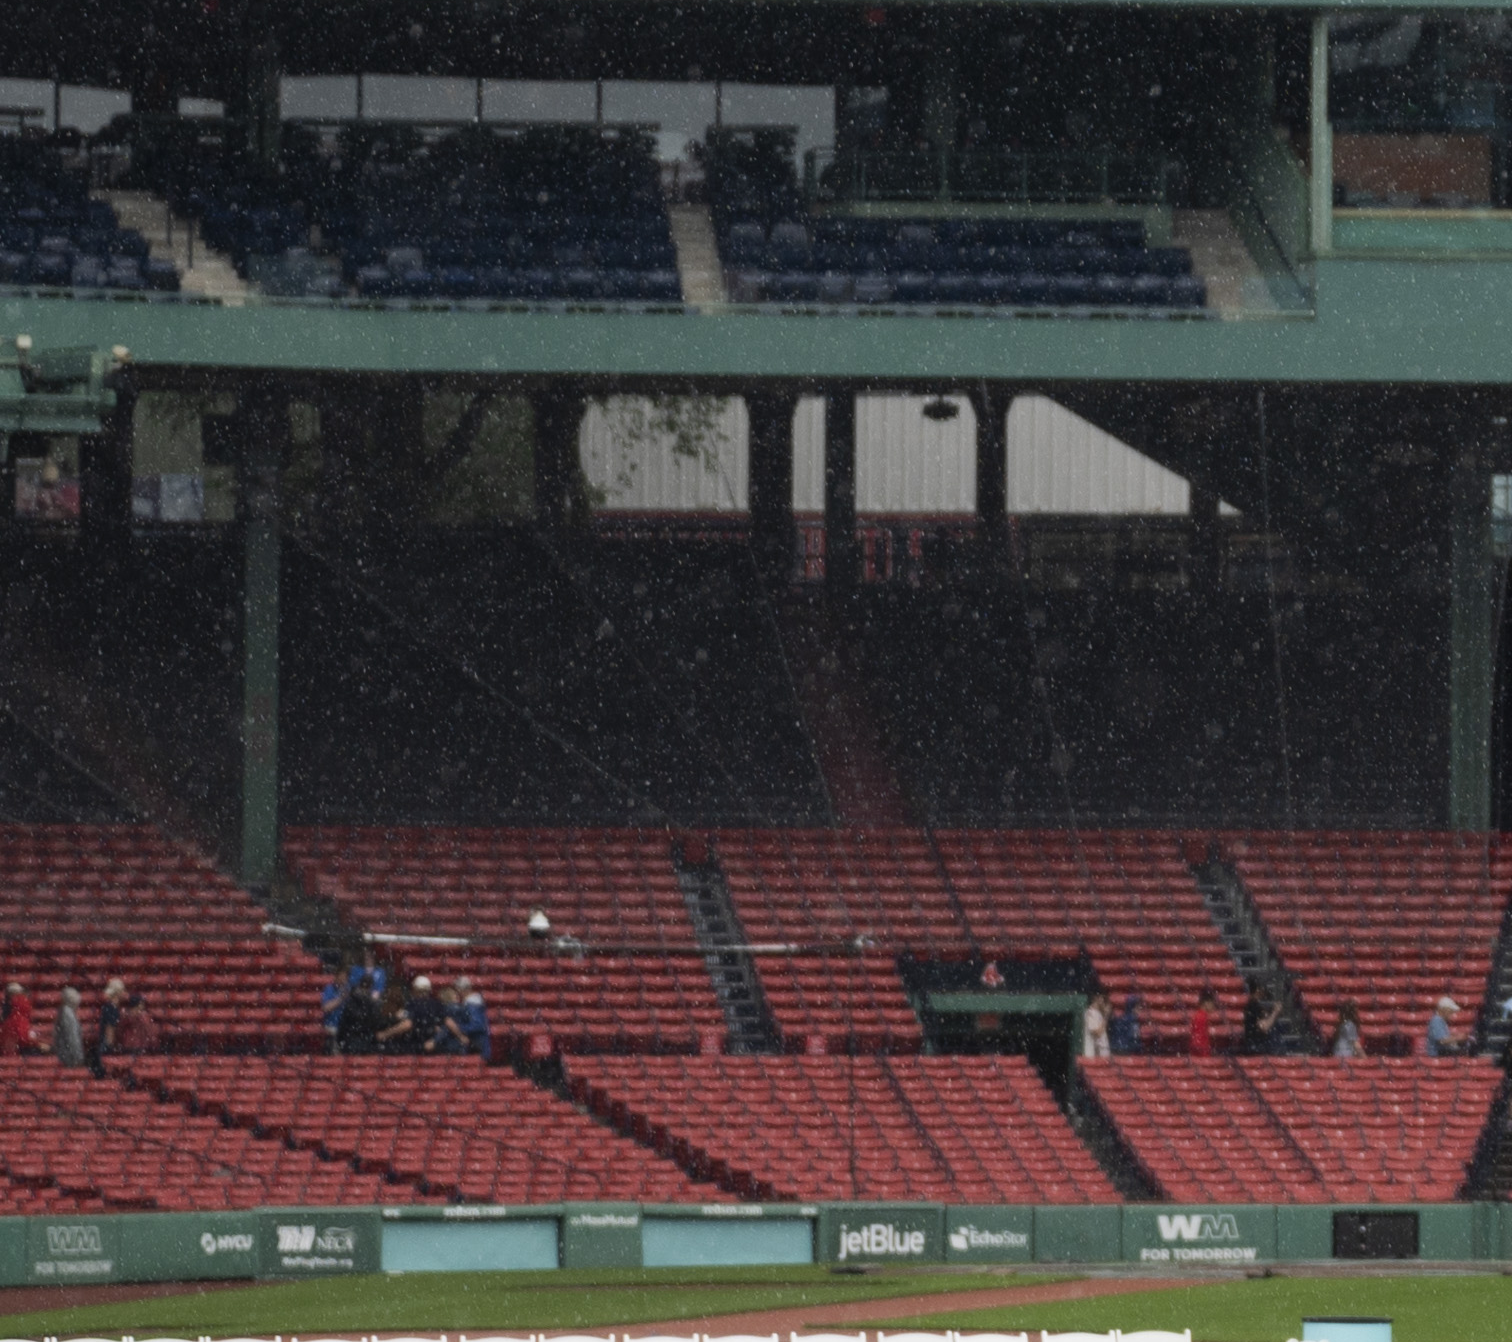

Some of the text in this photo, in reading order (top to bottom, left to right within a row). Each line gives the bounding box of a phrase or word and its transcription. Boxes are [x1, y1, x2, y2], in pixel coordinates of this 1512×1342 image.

[1157, 1214, 1239, 1240] WM
[838, 1223, 925, 1260] jetBlue
[1140, 1247, 1256, 1261] FOR TOMORROW
